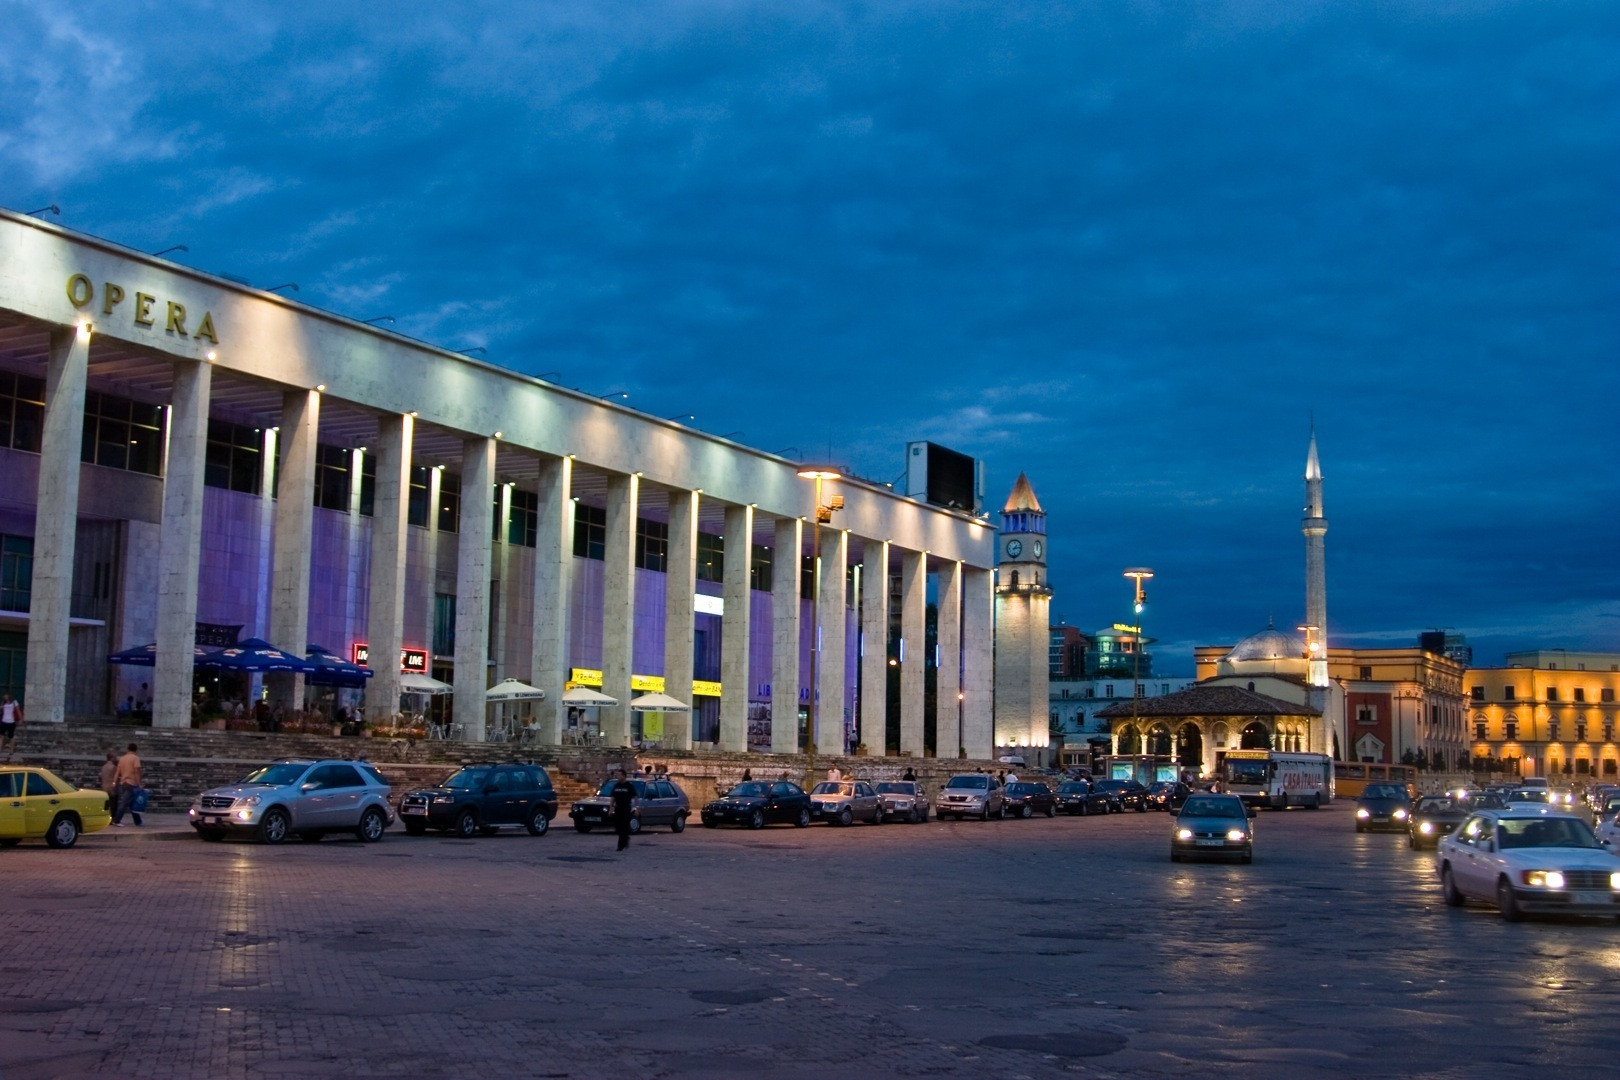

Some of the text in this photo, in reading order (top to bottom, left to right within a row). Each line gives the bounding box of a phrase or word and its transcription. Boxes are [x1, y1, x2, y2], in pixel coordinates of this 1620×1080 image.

[66, 273, 219, 344] OPERA
[408, 655, 424, 666] LIVE
[1283, 772, 1300, 790] CASA
